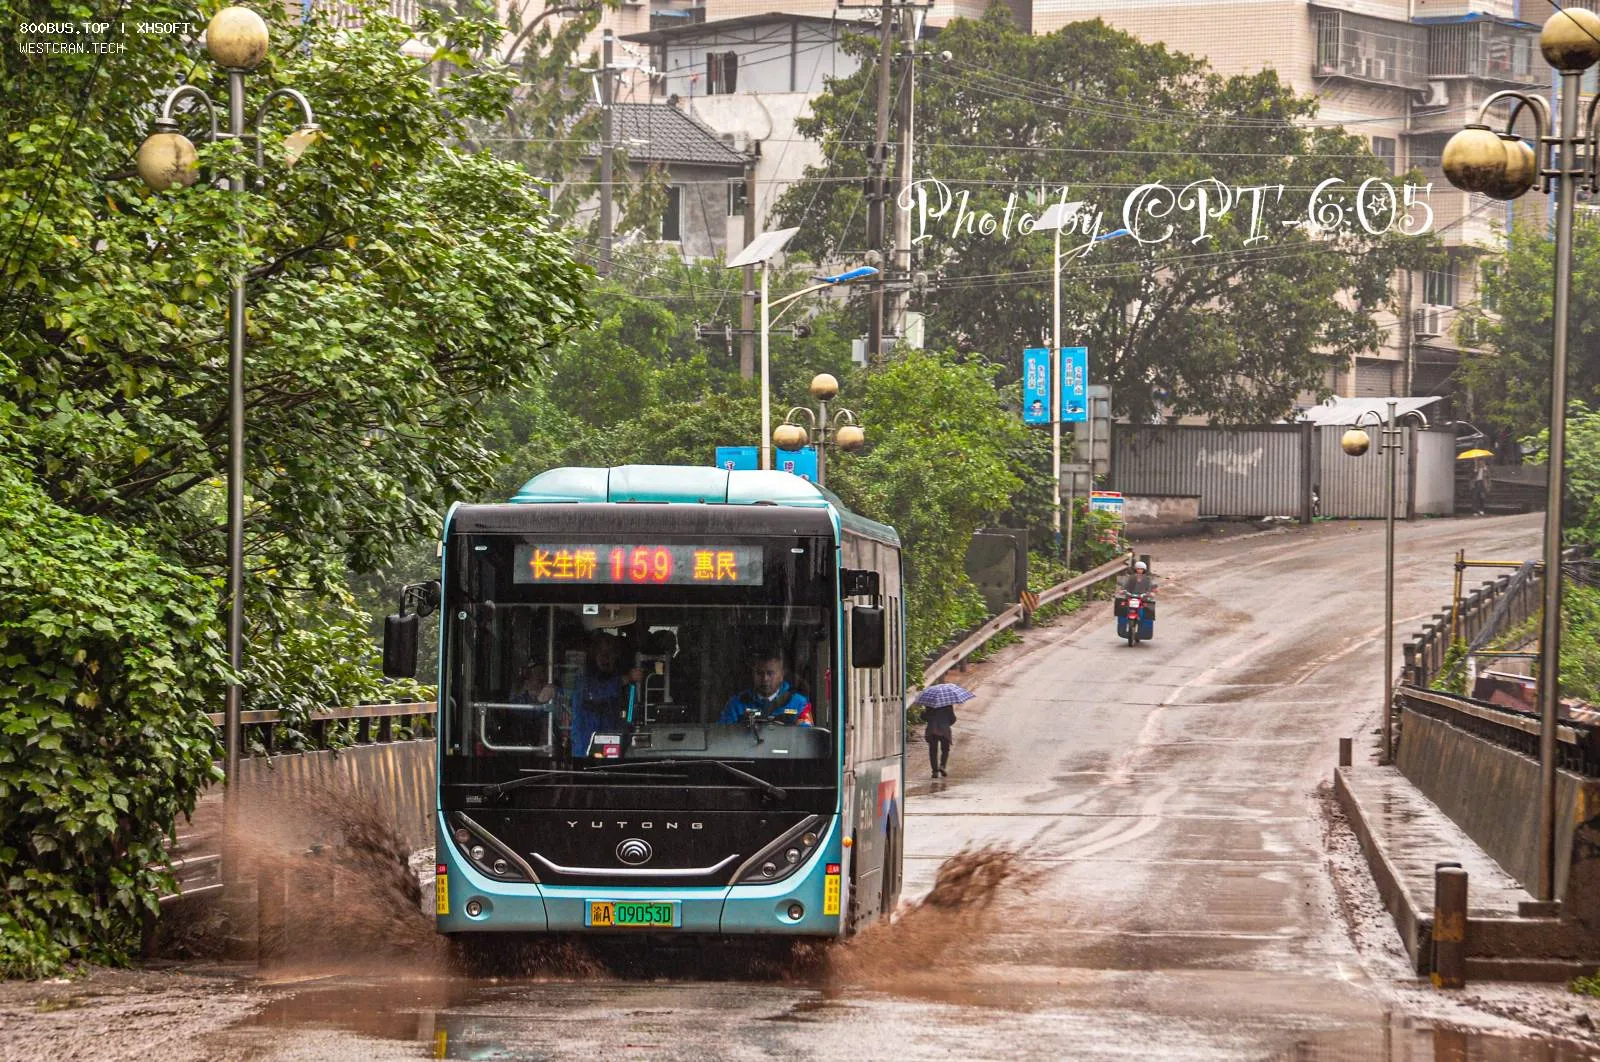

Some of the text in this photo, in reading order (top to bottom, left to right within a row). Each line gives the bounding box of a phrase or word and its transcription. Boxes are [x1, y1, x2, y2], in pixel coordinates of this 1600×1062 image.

[529, 546, 737, 582] 长生桥 159 惠民
[567, 820, 703, 830] YUTONG
